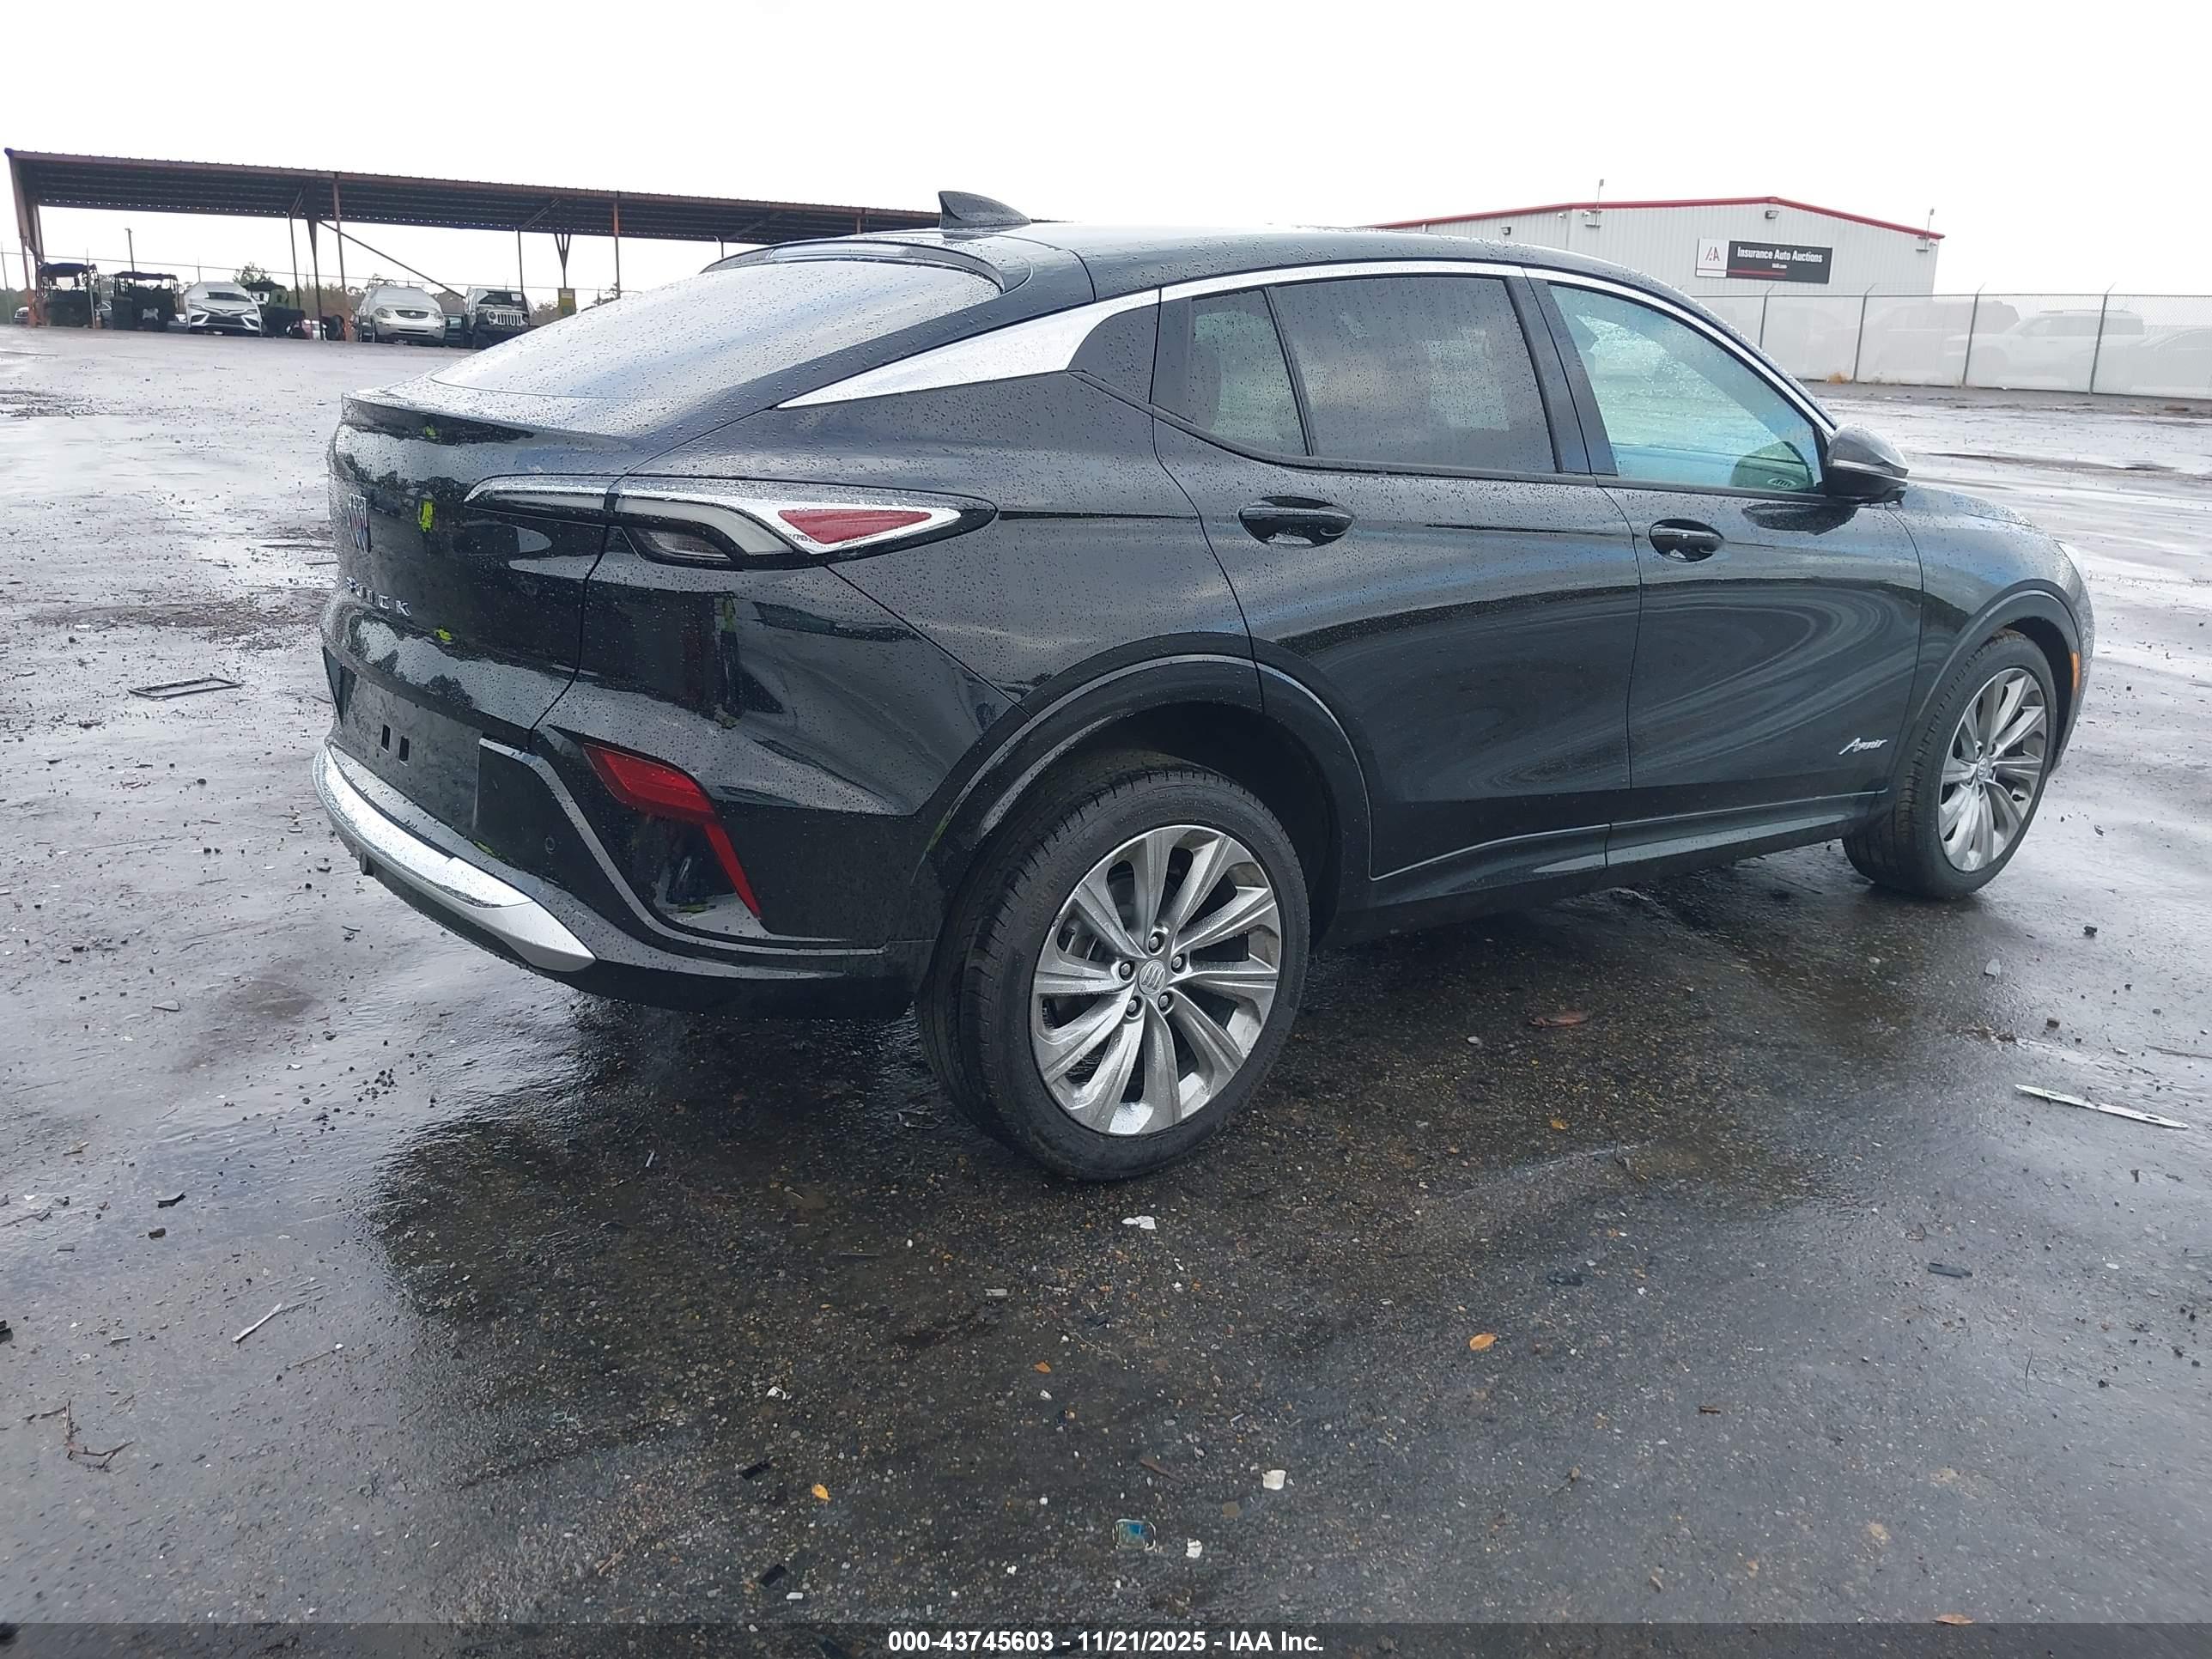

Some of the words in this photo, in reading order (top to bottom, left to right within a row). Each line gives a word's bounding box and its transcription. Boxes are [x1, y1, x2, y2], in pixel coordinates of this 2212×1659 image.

[1737, 246, 1773, 259] Insurance
[1774, 248, 1791, 261] Auto
[1792, 250, 1823, 263] Auctions
